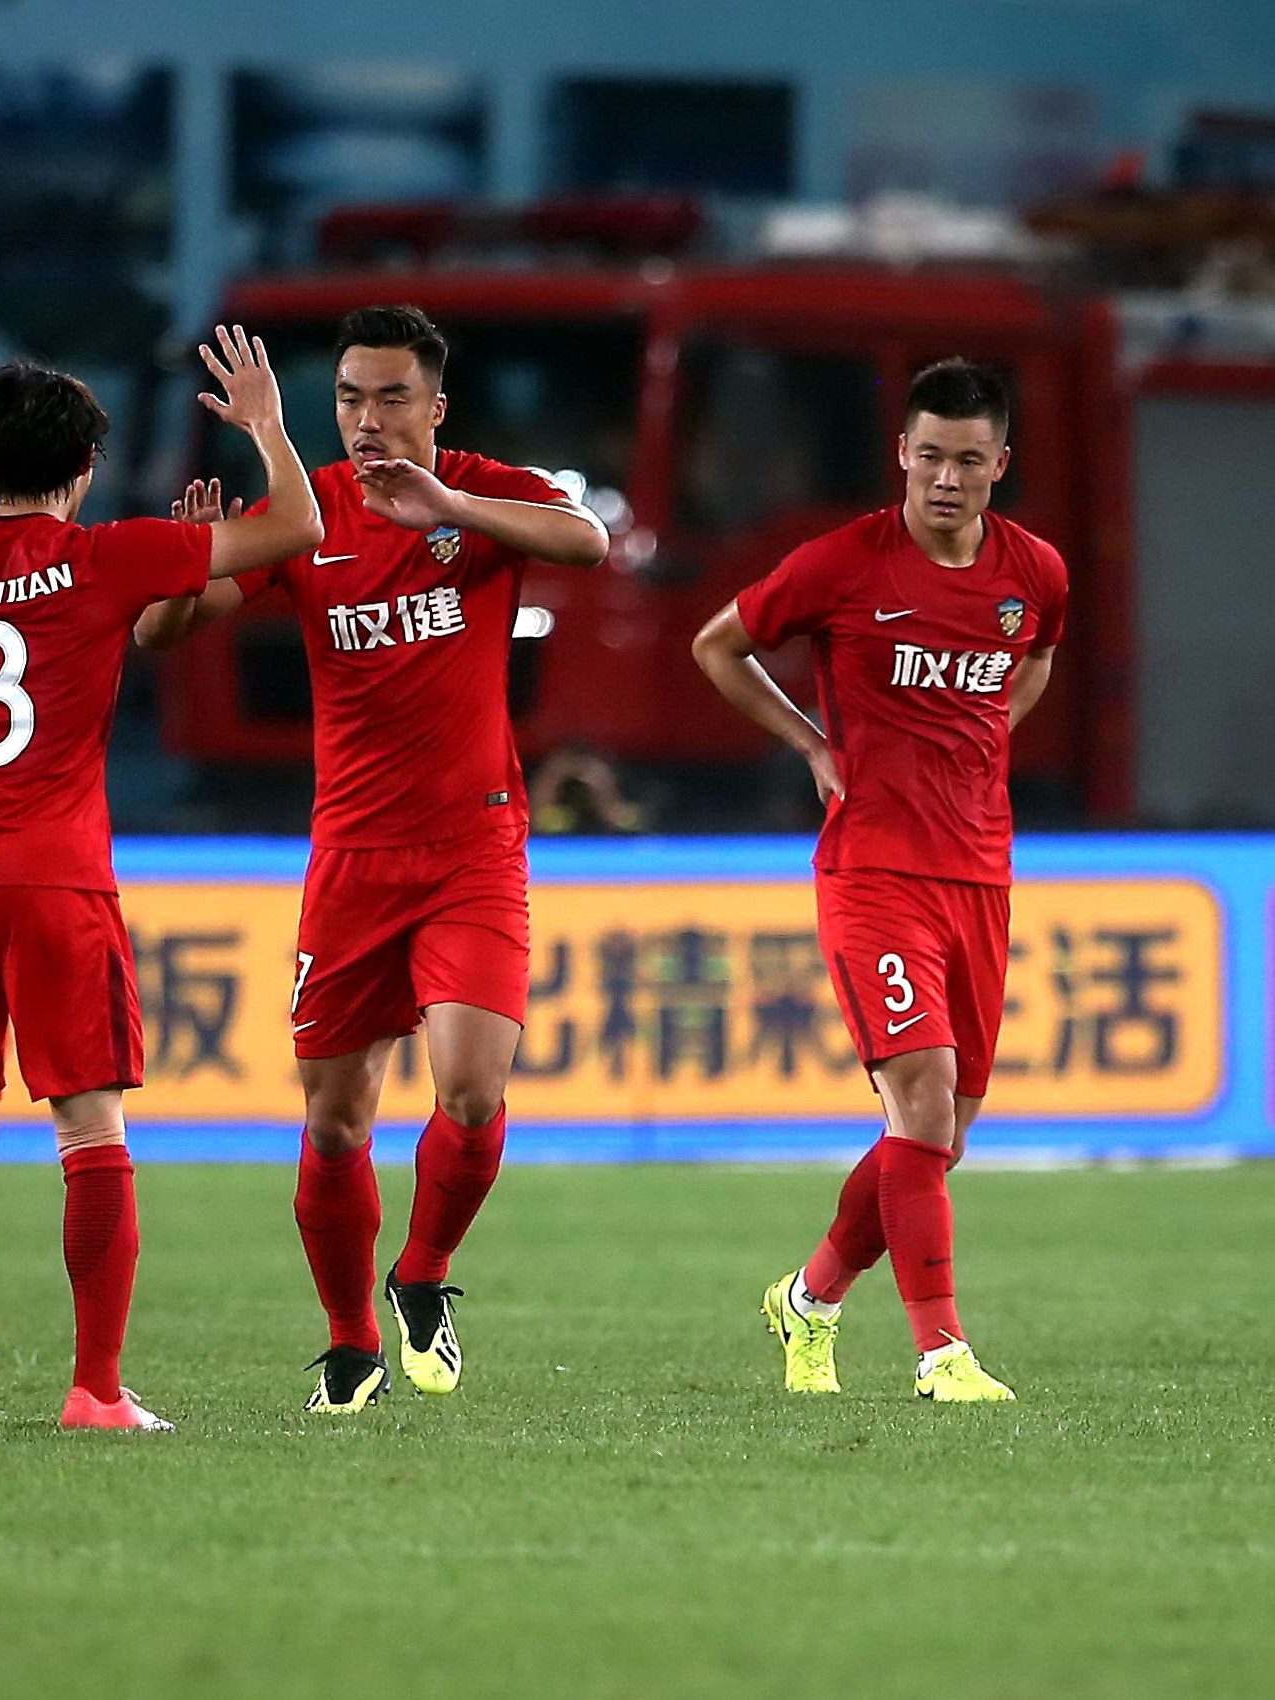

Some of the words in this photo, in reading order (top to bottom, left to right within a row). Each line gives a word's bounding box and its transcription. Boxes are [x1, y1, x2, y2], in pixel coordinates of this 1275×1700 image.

[327, 586, 466, 651] 权健
[890, 643, 1013, 693] 权健
[877, 952, 914, 1013] 3
